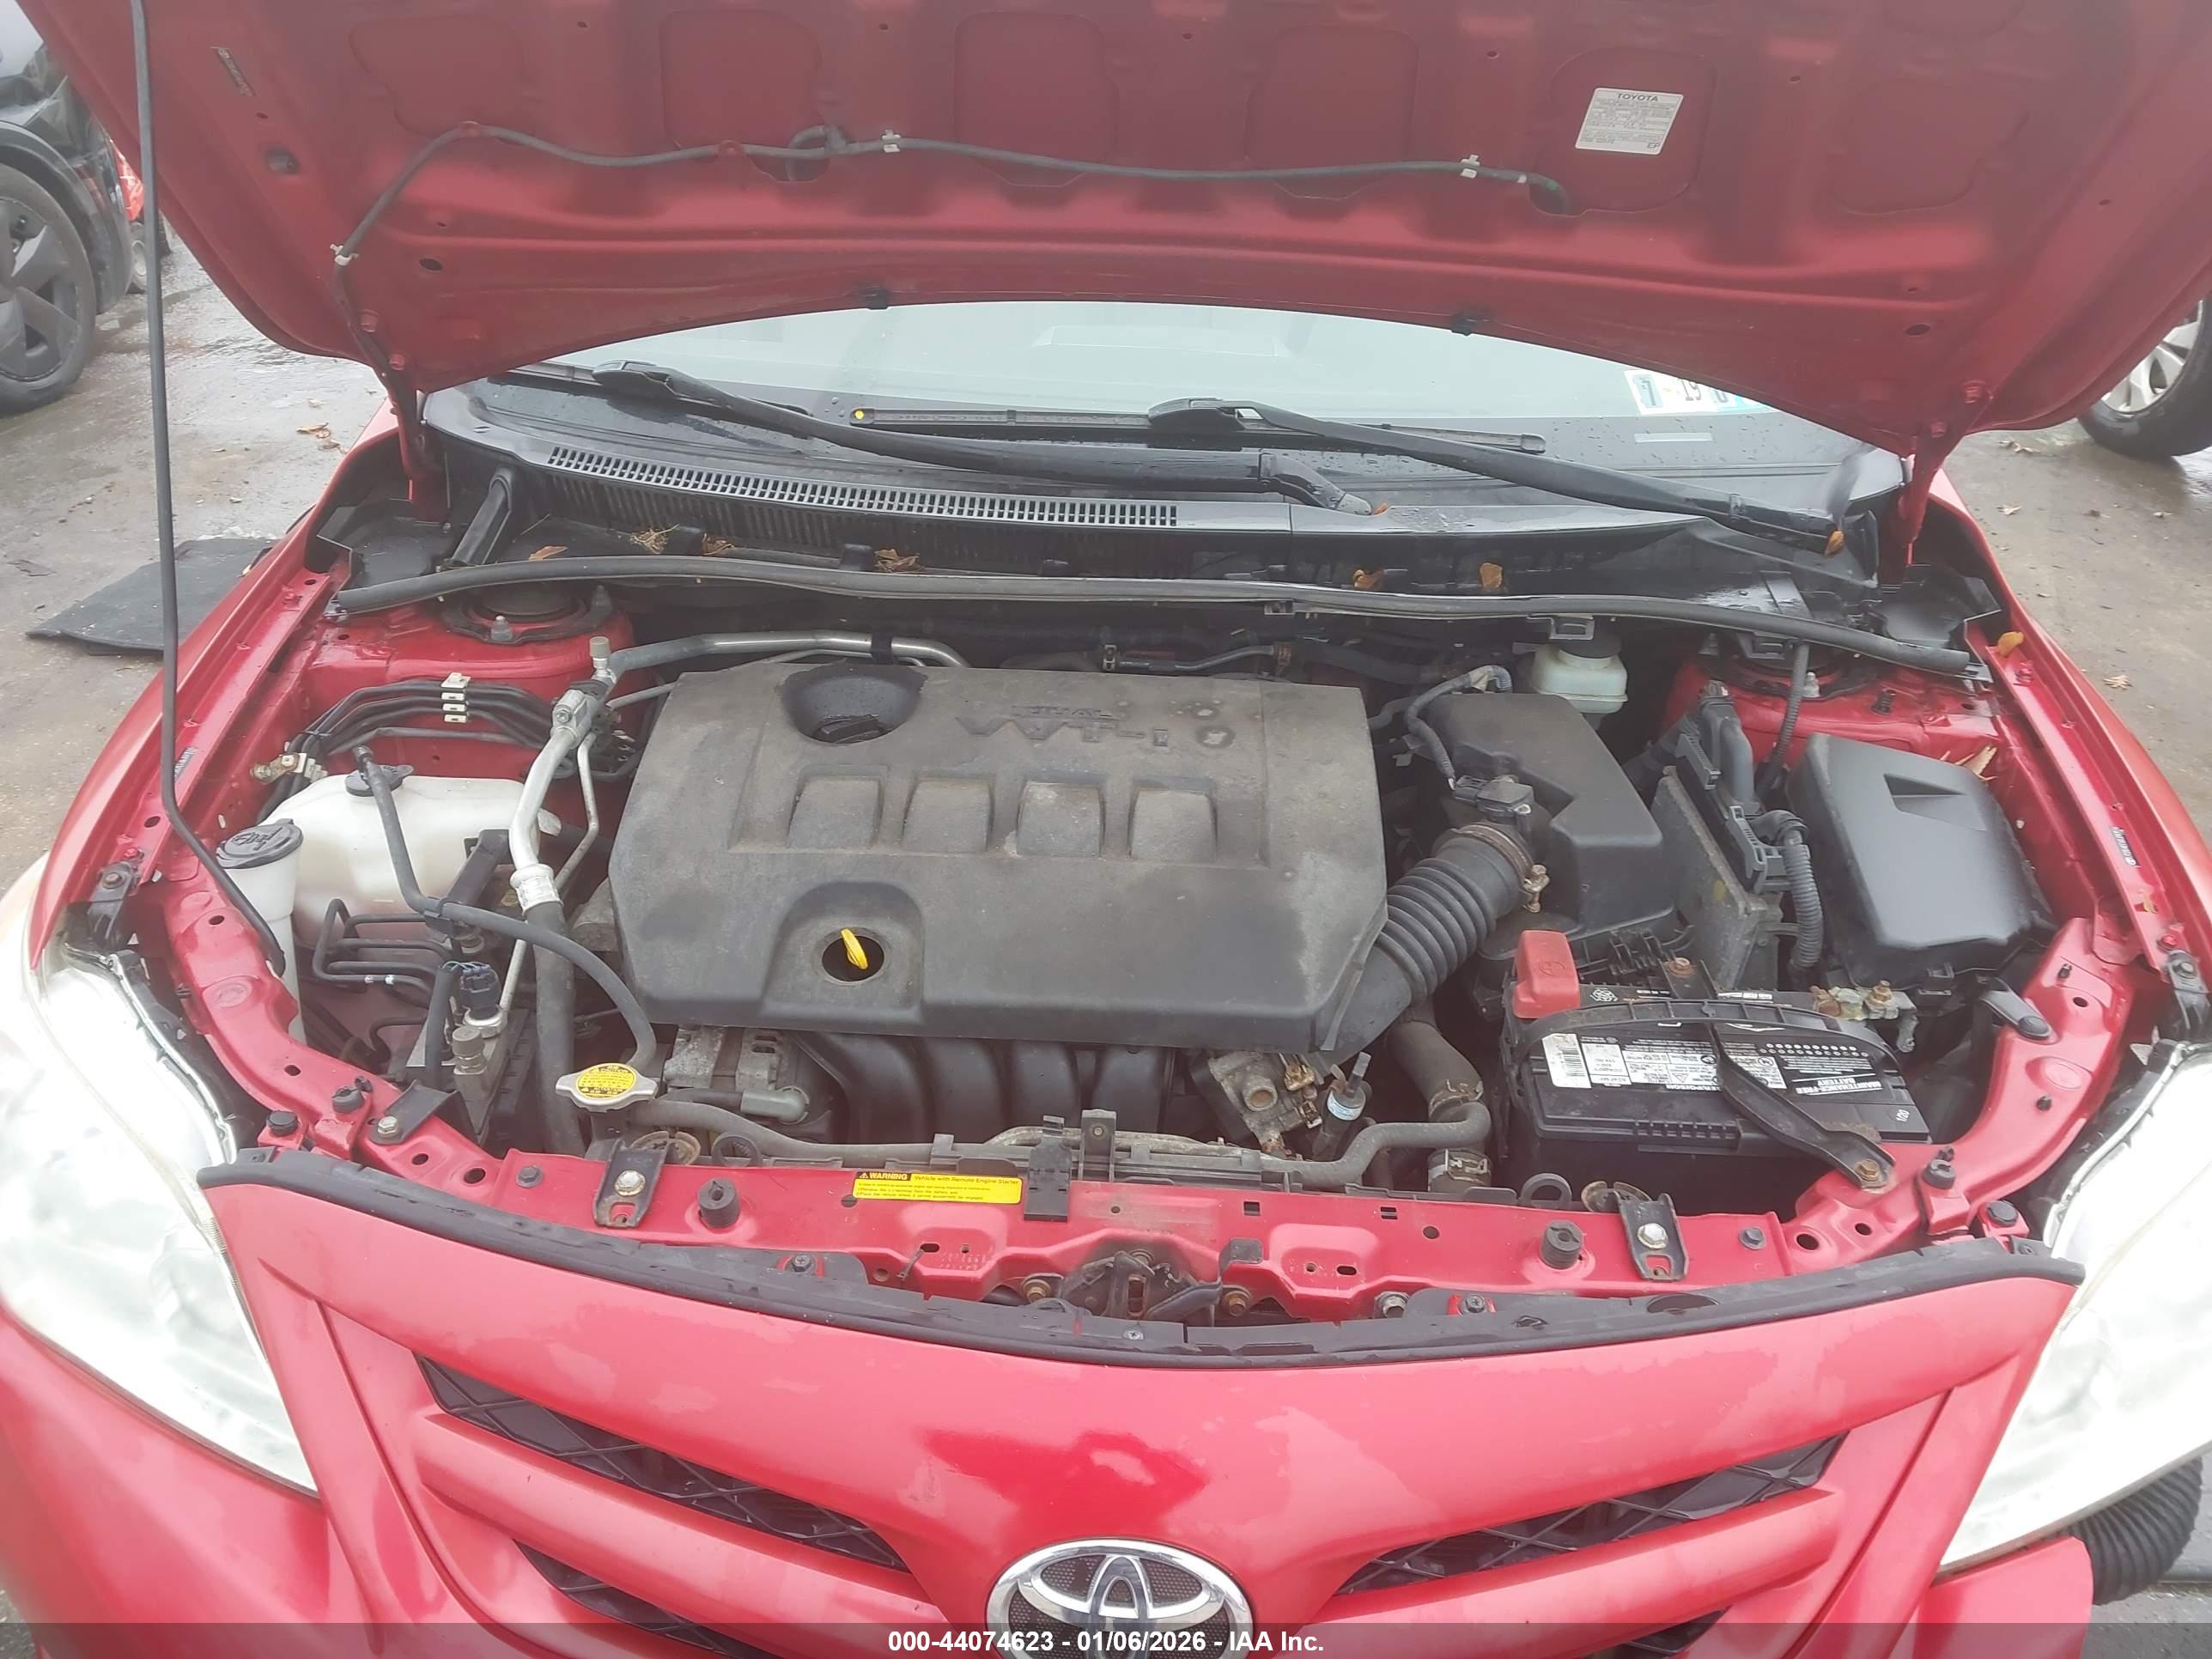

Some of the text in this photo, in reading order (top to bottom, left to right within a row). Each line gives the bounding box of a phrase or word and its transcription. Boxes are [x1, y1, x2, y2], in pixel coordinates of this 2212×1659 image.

[1617, 93, 1659, 102] TOYOTA
[1818, 1078, 1856, 1087] BATTERY
[869, 1172, 908, 1181] WARNING
